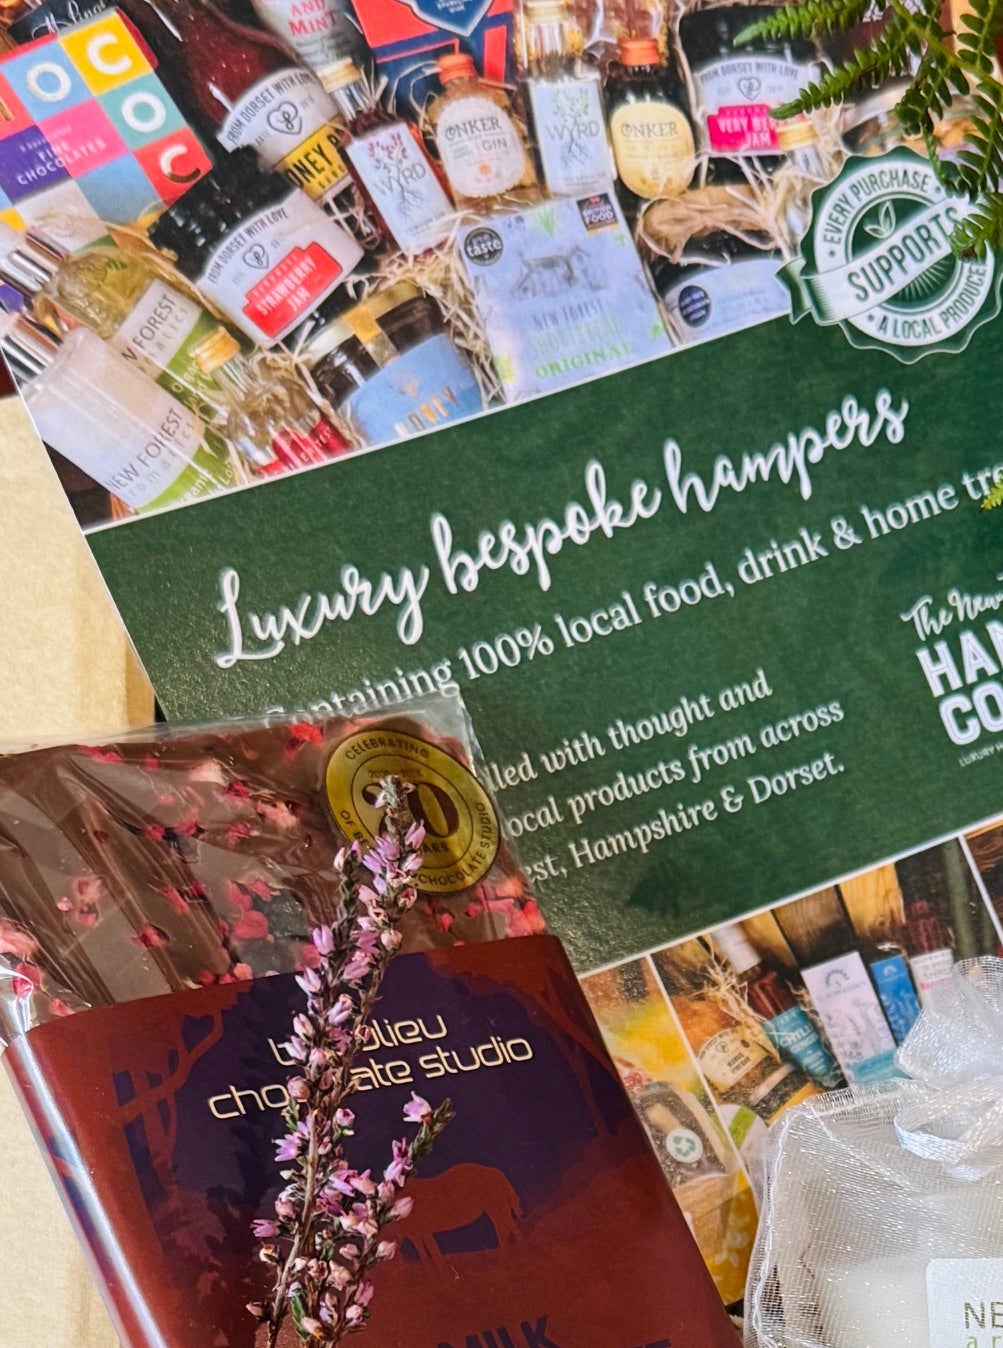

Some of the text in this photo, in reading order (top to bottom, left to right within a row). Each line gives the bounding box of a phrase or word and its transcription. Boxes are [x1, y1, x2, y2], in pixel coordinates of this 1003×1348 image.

[288, 11, 336, 36] MINT
[17, 138, 107, 185] CHOCOLATES
[823, 169, 932, 245] EVERY PURCHASE
[135, 294, 178, 348] FOREST
[255, 256, 317, 316] STRAWBERRY
[878, 263, 987, 339] A LOCAL PRODUCE
[214, 388, 909, 669] Luxury bespoke hampers
[458, 623, 555, 681] 100%
[554, 590, 643, 648] local
[644, 562, 737, 617] food,
[738, 527, 830, 586] drink
[830, 514, 863, 551] &
[860, 482, 960, 542] home
[900, 594, 953, 642] The
[345, 738, 430, 760] CELEBRATING
[542, 731, 605, 774] with
[605, 700, 714, 757] thought
[718, 669, 774, 713] and
[566, 760, 688, 819] products
[687, 734, 757, 785] from
[759, 699, 845, 747] across
[958, 744, 995, 768] LUXURY
[418, 852, 488, 885] CHOCOLATE
[475, 801, 492, 850] STUDIO
[570, 801, 718, 869] Hampshire
[722, 784, 746, 813] &
[747, 752, 846, 804] Dorset.
[208, 1036, 534, 1119] choate studio
